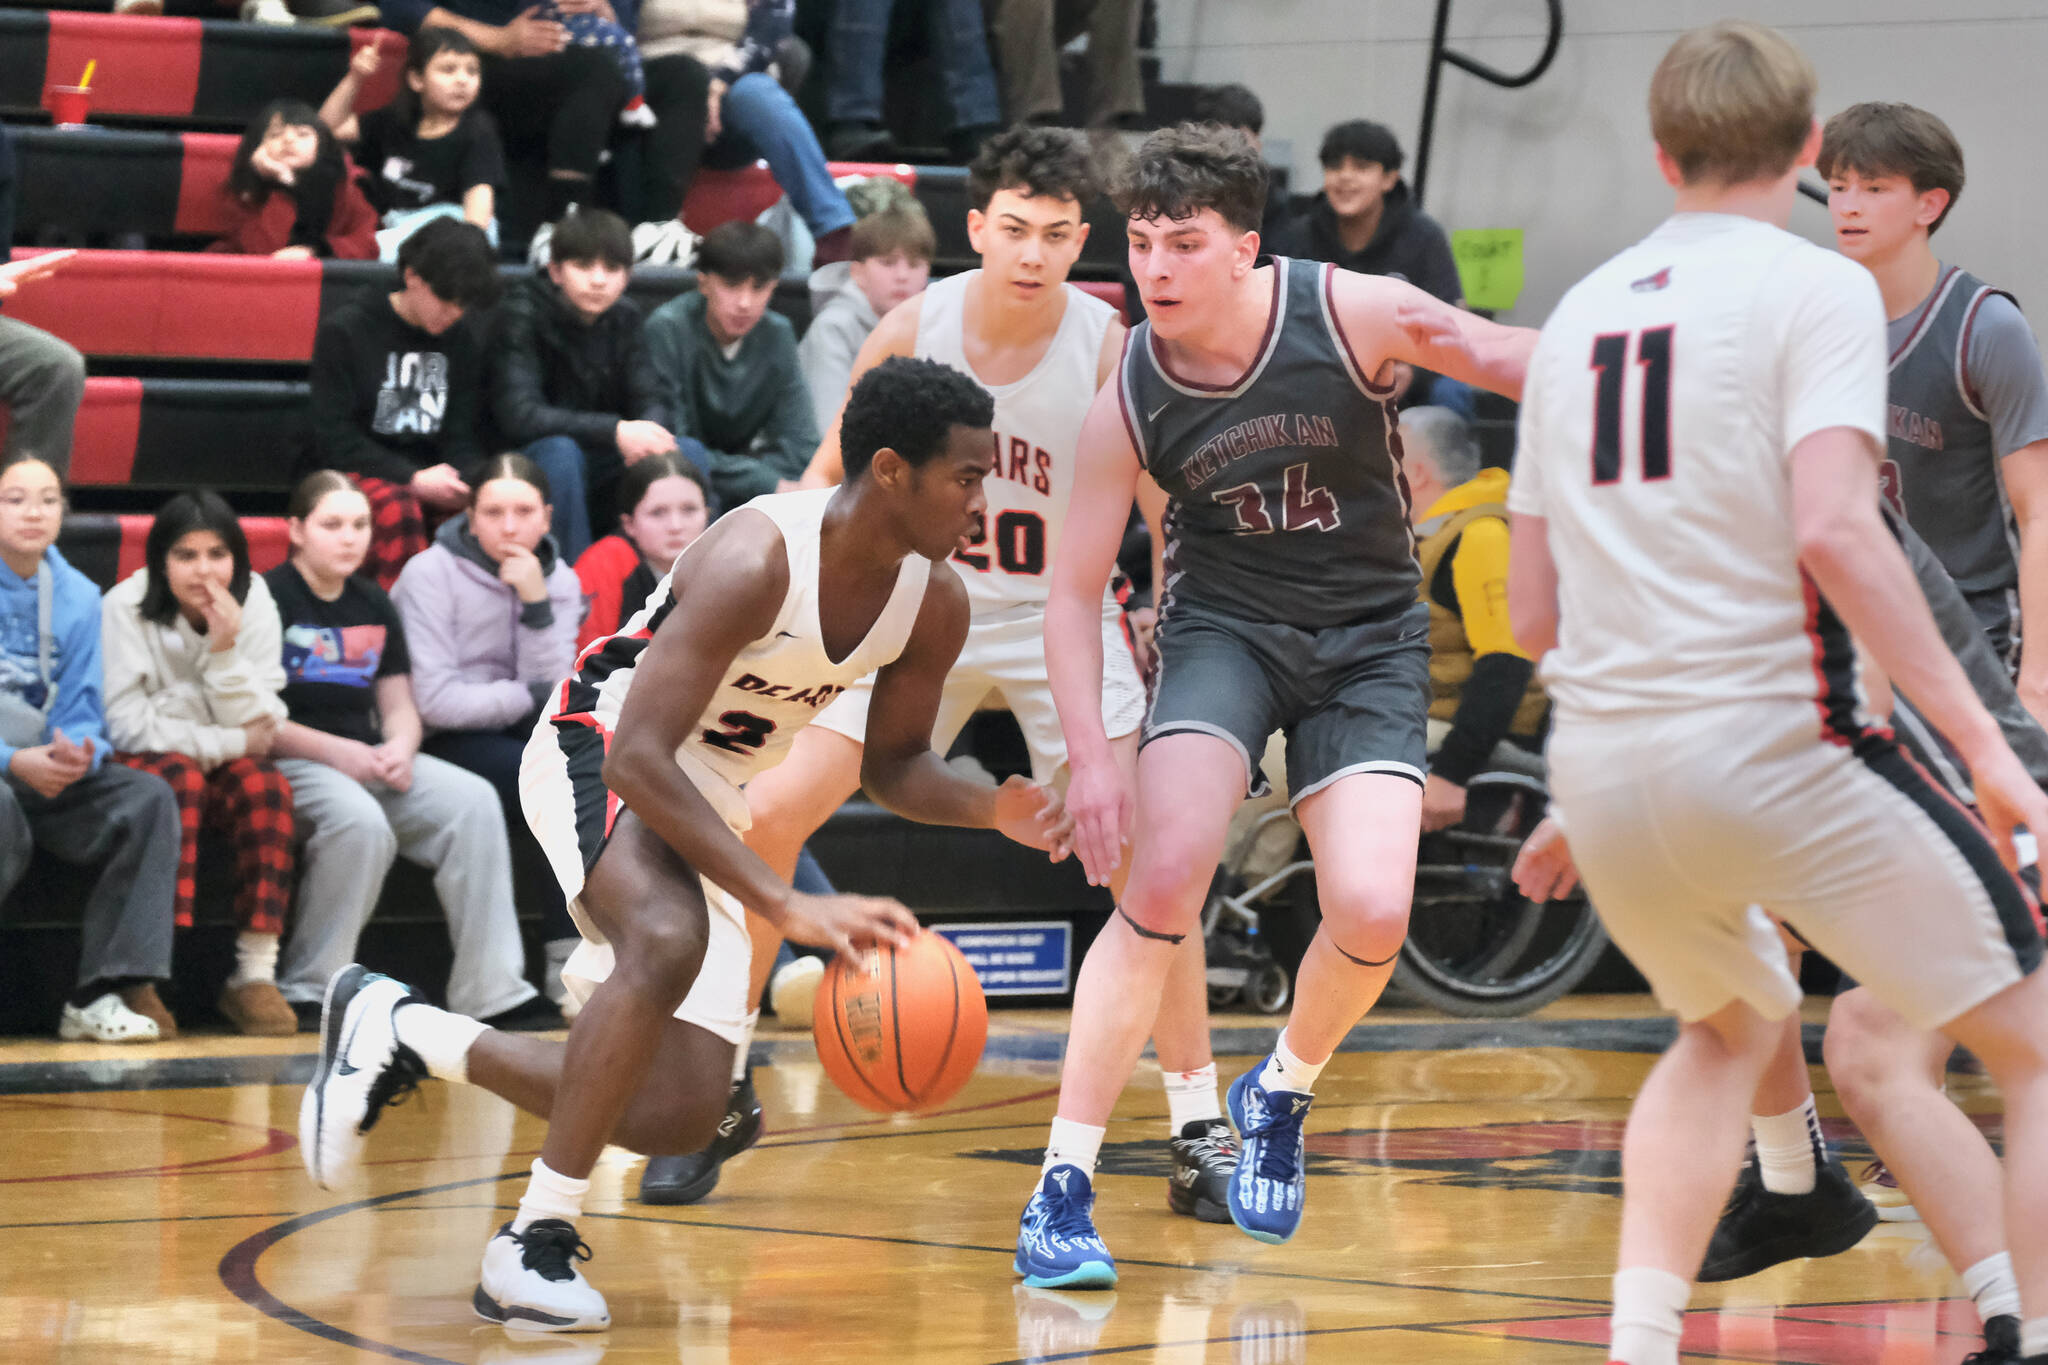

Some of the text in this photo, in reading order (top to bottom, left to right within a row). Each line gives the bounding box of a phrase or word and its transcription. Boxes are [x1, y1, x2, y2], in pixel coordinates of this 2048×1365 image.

[1590, 323, 1676, 486] 11
[1181, 414, 1338, 490] KETCHIKAN
[1211, 462, 1342, 536] 34
[951, 508, 1047, 577] 20
[697, 710, 778, 757] 2
